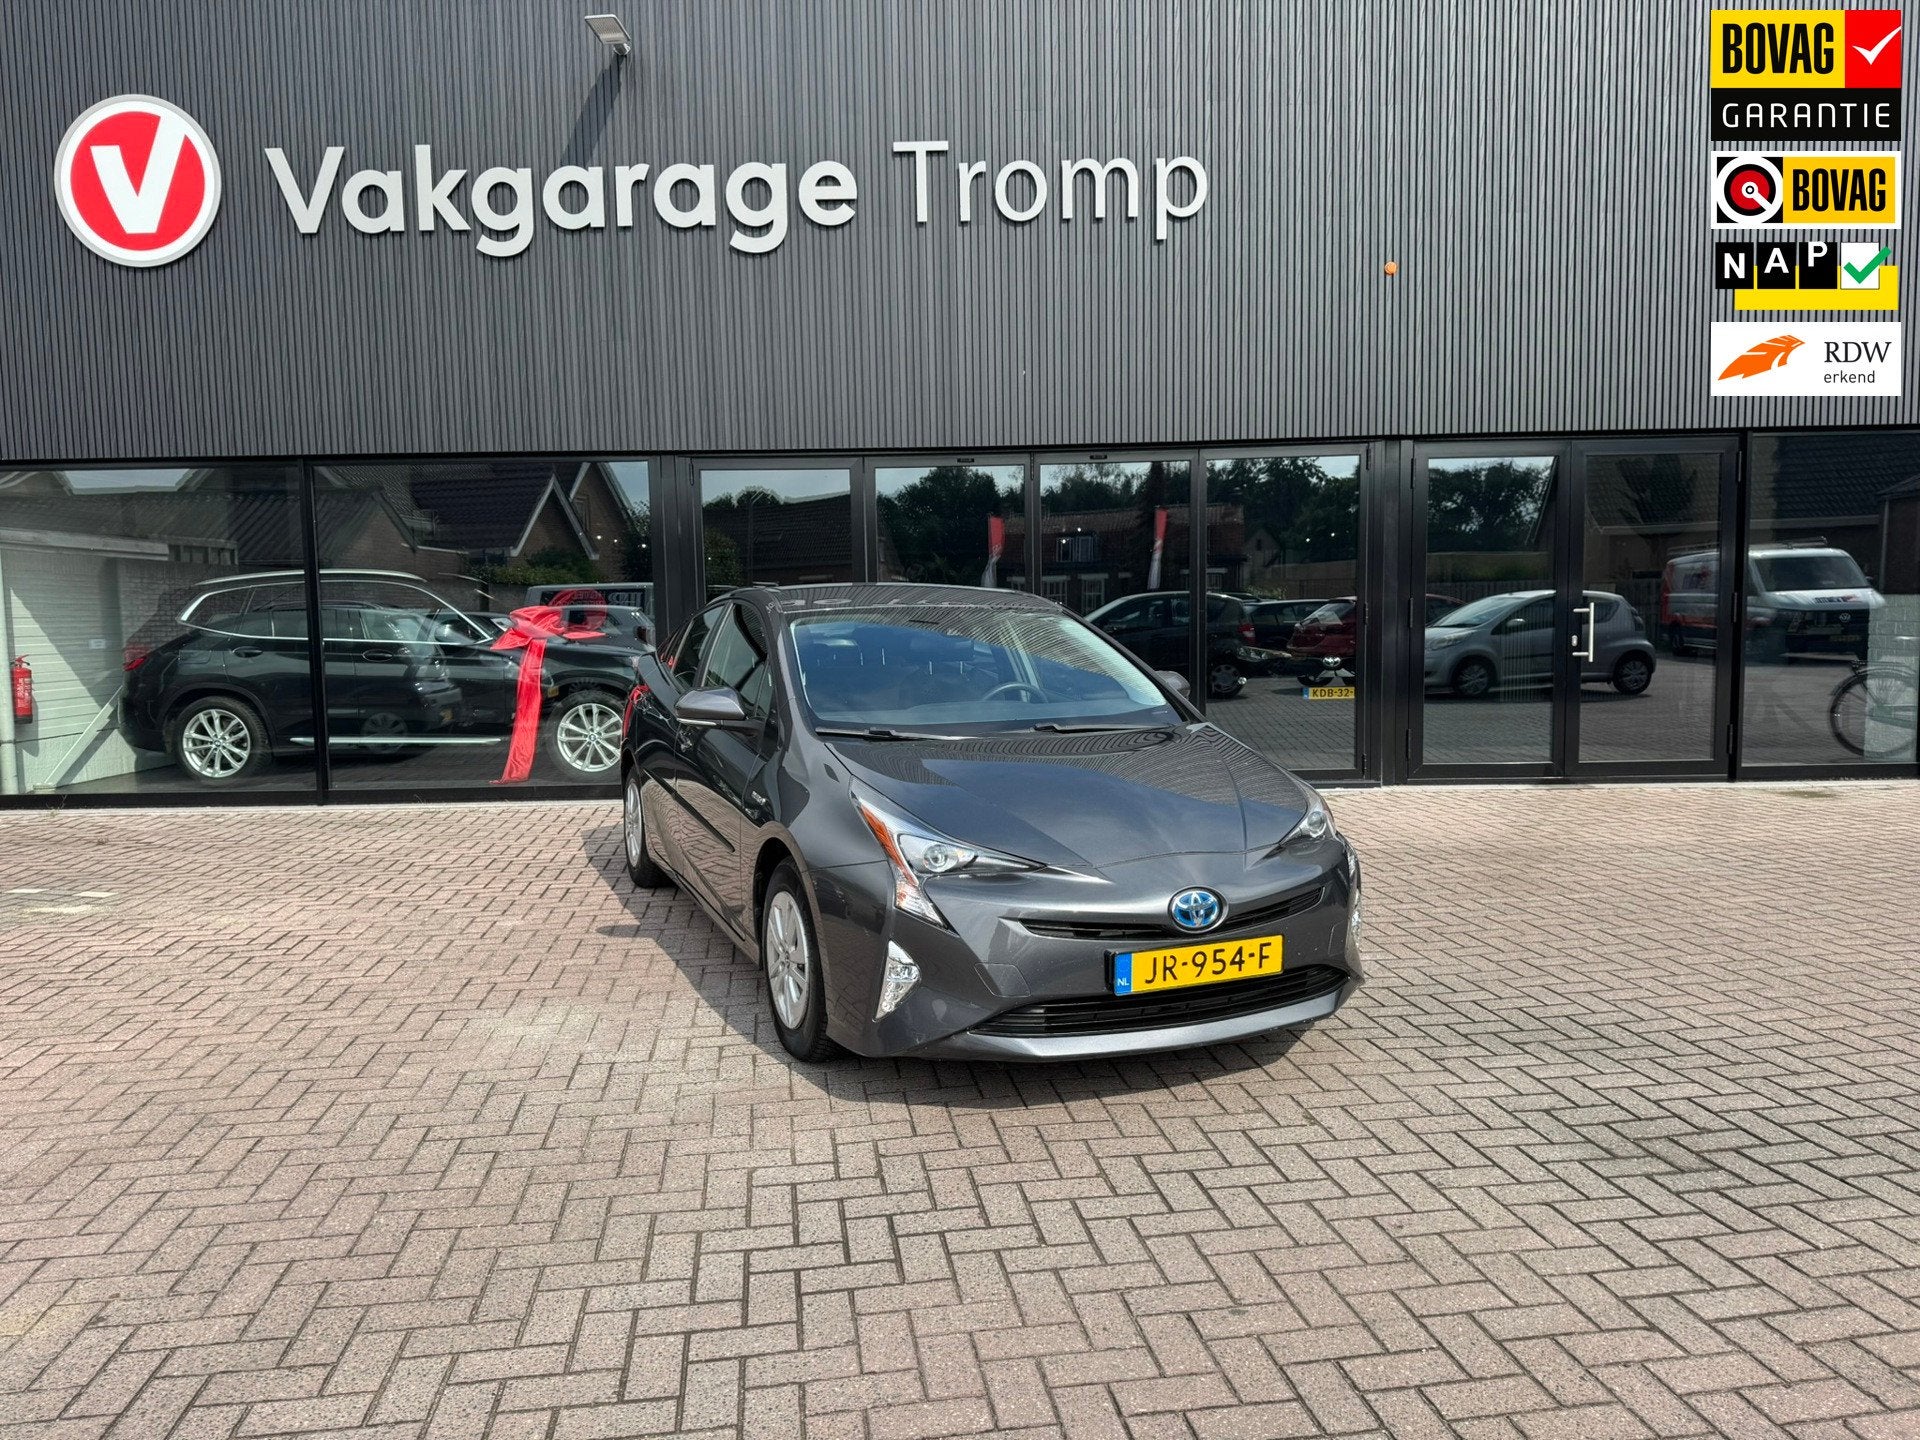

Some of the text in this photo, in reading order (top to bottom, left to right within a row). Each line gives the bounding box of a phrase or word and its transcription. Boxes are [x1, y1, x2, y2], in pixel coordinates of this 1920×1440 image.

[264, 140, 1208, 257] Vakgarage Tromp
[1117, 942, 1272, 987] NL JR-954-F
